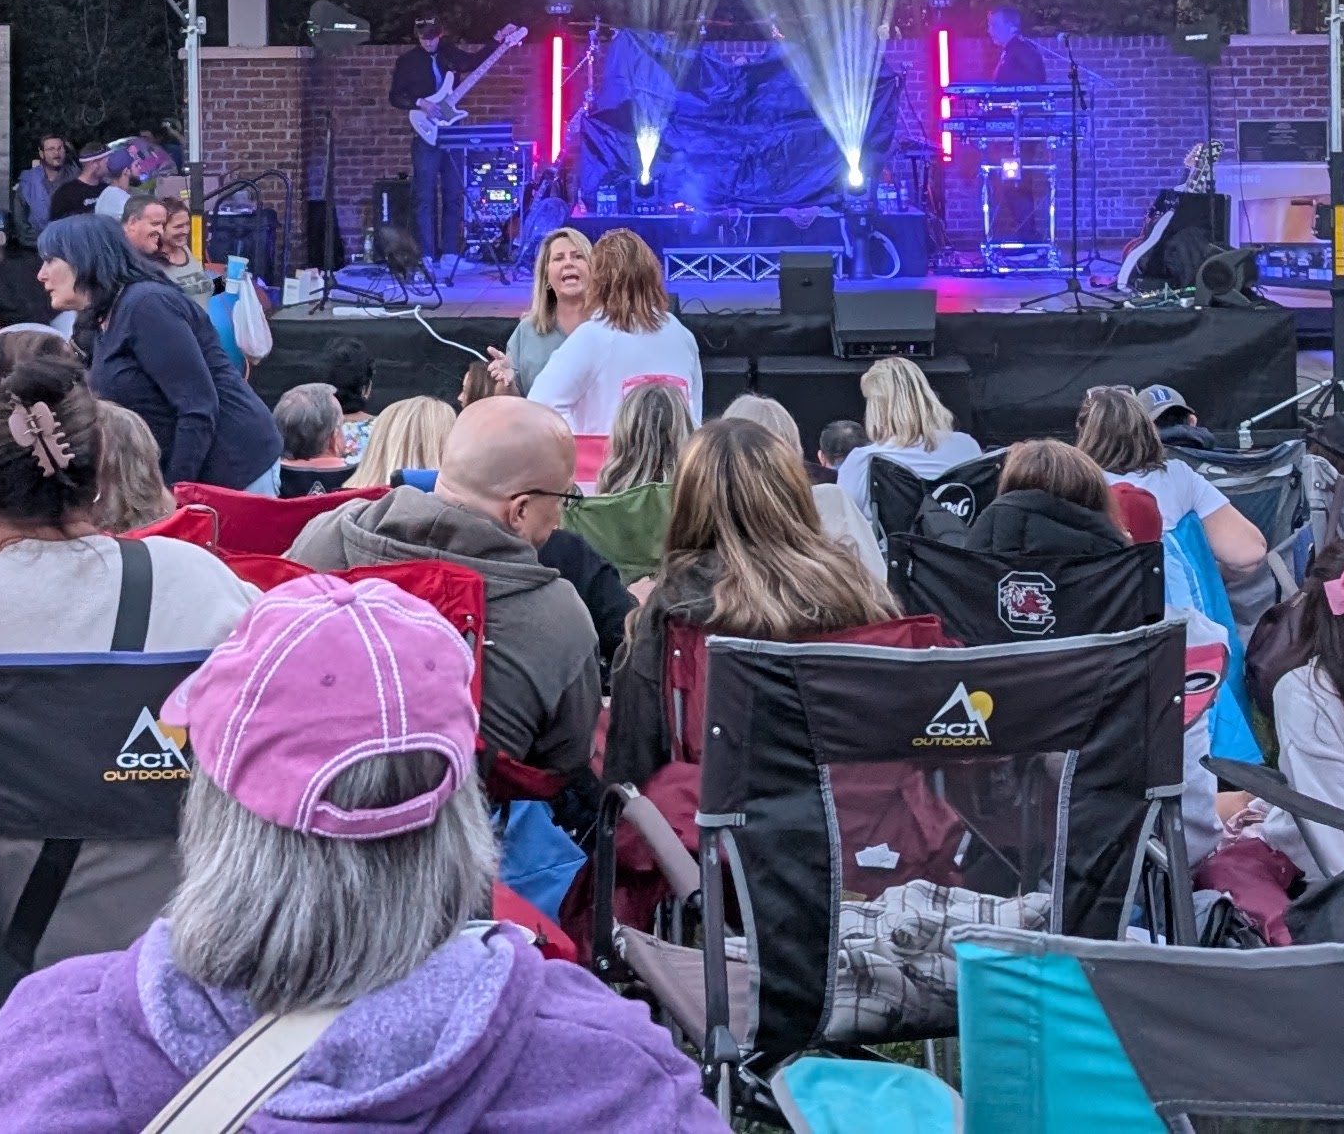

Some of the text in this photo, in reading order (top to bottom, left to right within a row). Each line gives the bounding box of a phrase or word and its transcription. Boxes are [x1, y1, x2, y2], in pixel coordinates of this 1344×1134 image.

[925, 722, 978, 737] GCI
[912, 737, 985, 746] OUTDOOR
[116, 752, 174, 768] GCI
[103, 768, 186, 782] OUTDOOR
